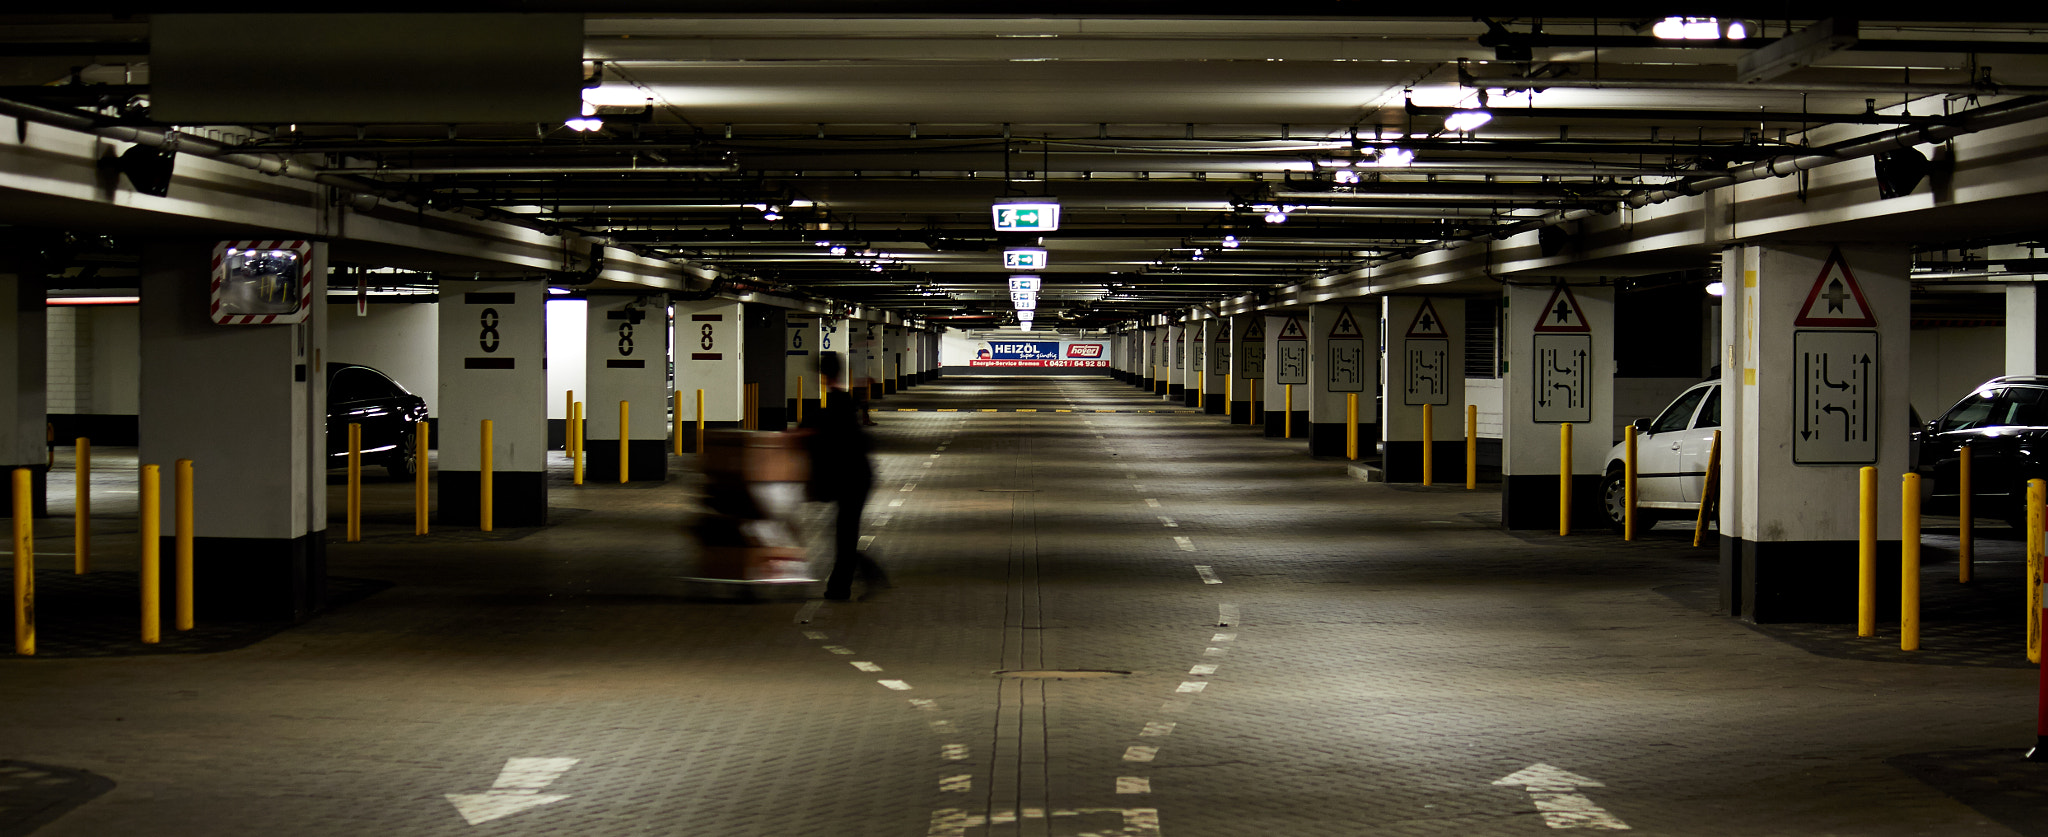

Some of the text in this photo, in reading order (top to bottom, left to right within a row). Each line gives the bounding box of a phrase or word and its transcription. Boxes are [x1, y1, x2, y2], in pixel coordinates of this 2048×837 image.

[479, 307, 499, 353] 8
[618, 322, 634, 356] 8
[700, 323, 713, 351] 8
[792, 329, 802, 349] 6
[823, 332, 831, 349] 6
[995, 343, 1041, 354] HEIZÖL
